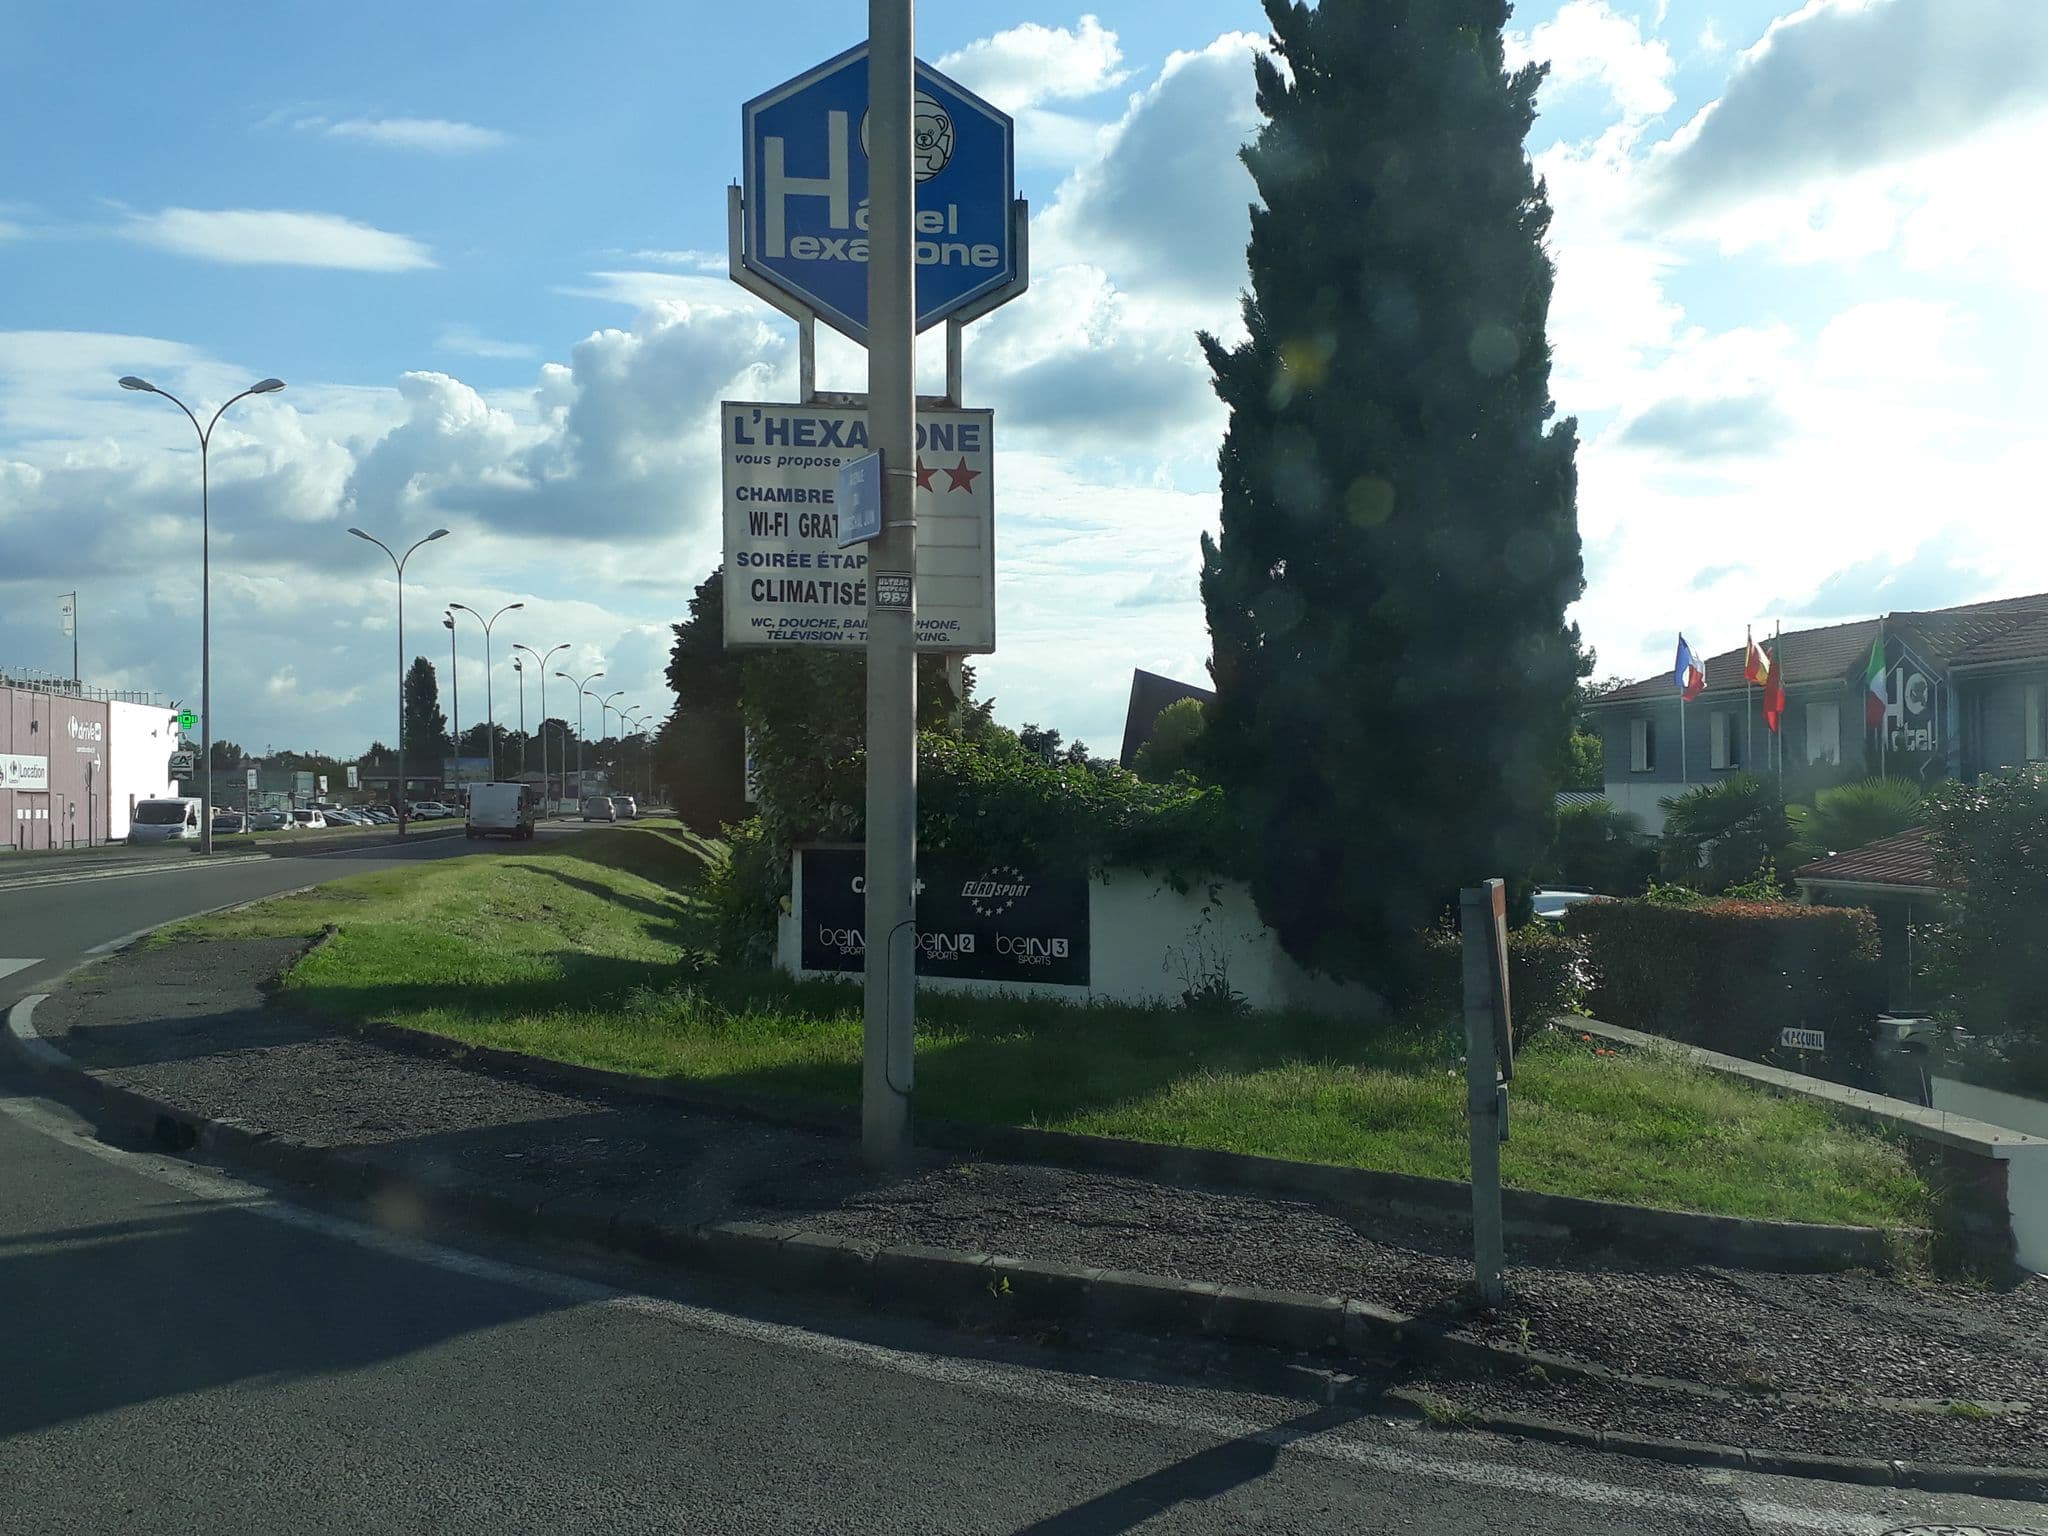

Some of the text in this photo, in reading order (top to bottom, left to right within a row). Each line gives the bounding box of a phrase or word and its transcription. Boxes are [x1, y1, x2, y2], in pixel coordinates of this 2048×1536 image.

[790, 234, 999, 268] exaone
[735, 455, 841, 468] vous propose
[736, 486, 834, 504] CHAMBRE
[750, 511, 788, 538] WI-FI
[737, 550, 812, 568] SOIRÉE
[751, 578, 867, 606] CLIMATISÉ
[878, 592, 909, 603] 1987
[751, 617, 775, 629] WC,
[779, 617, 840, 629] DOUCHE,
[767, 629, 844, 641] TÉLÉVISION
[19, 764, 45, 779] Location
[927, 950, 958, 961] SPORTS
[1018, 954, 1051, 966] SPORTS
